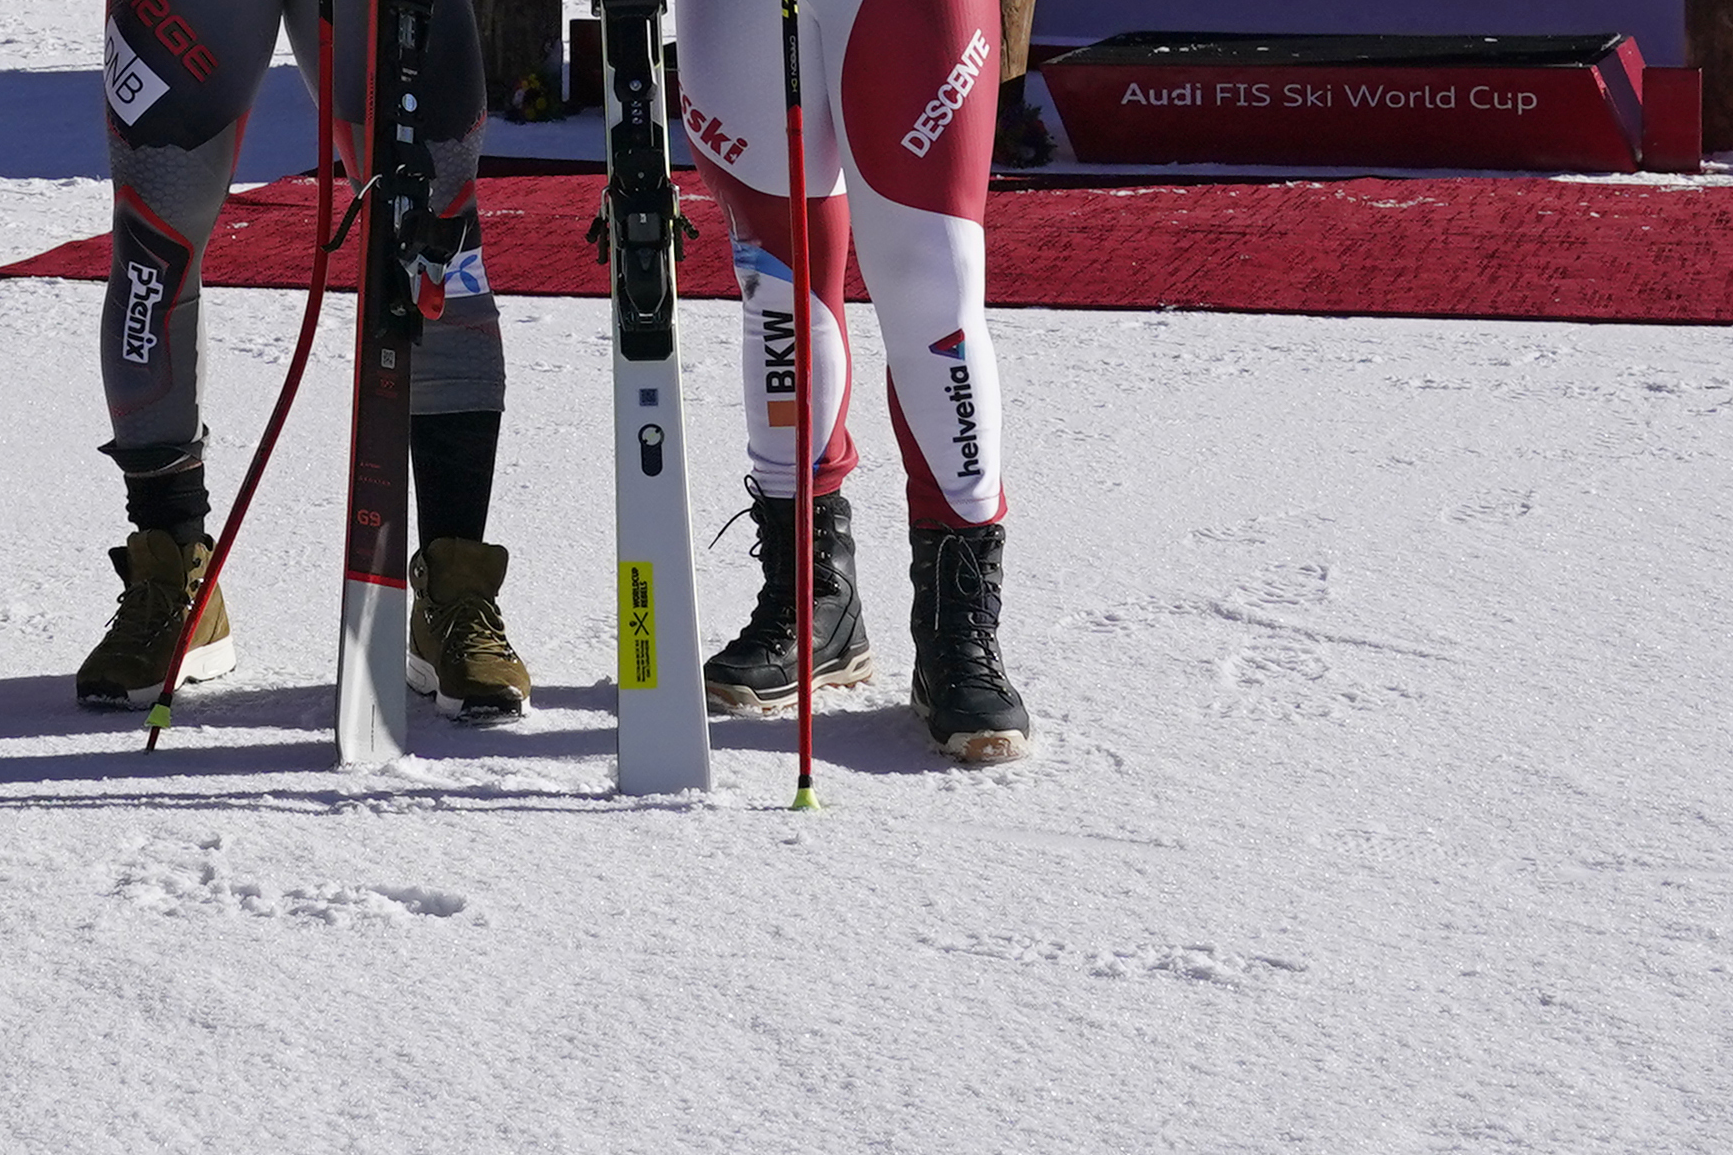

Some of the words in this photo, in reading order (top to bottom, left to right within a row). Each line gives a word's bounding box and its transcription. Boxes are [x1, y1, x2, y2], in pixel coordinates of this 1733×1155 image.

[901, 29, 989, 159] DESCENTE
[1121, 82, 1202, 107] Audi
[1216, 83, 1270, 107] FIS
[1282, 84, 1332, 109] Ski
[1344, 84, 1456, 110] World
[1468, 87, 1537, 115] Cup
[125, 263, 160, 361] phenix
[764, 309, 795, 394] BKW
[957, 364, 981, 478] helvetia
[357, 509, 381, 527] G9
